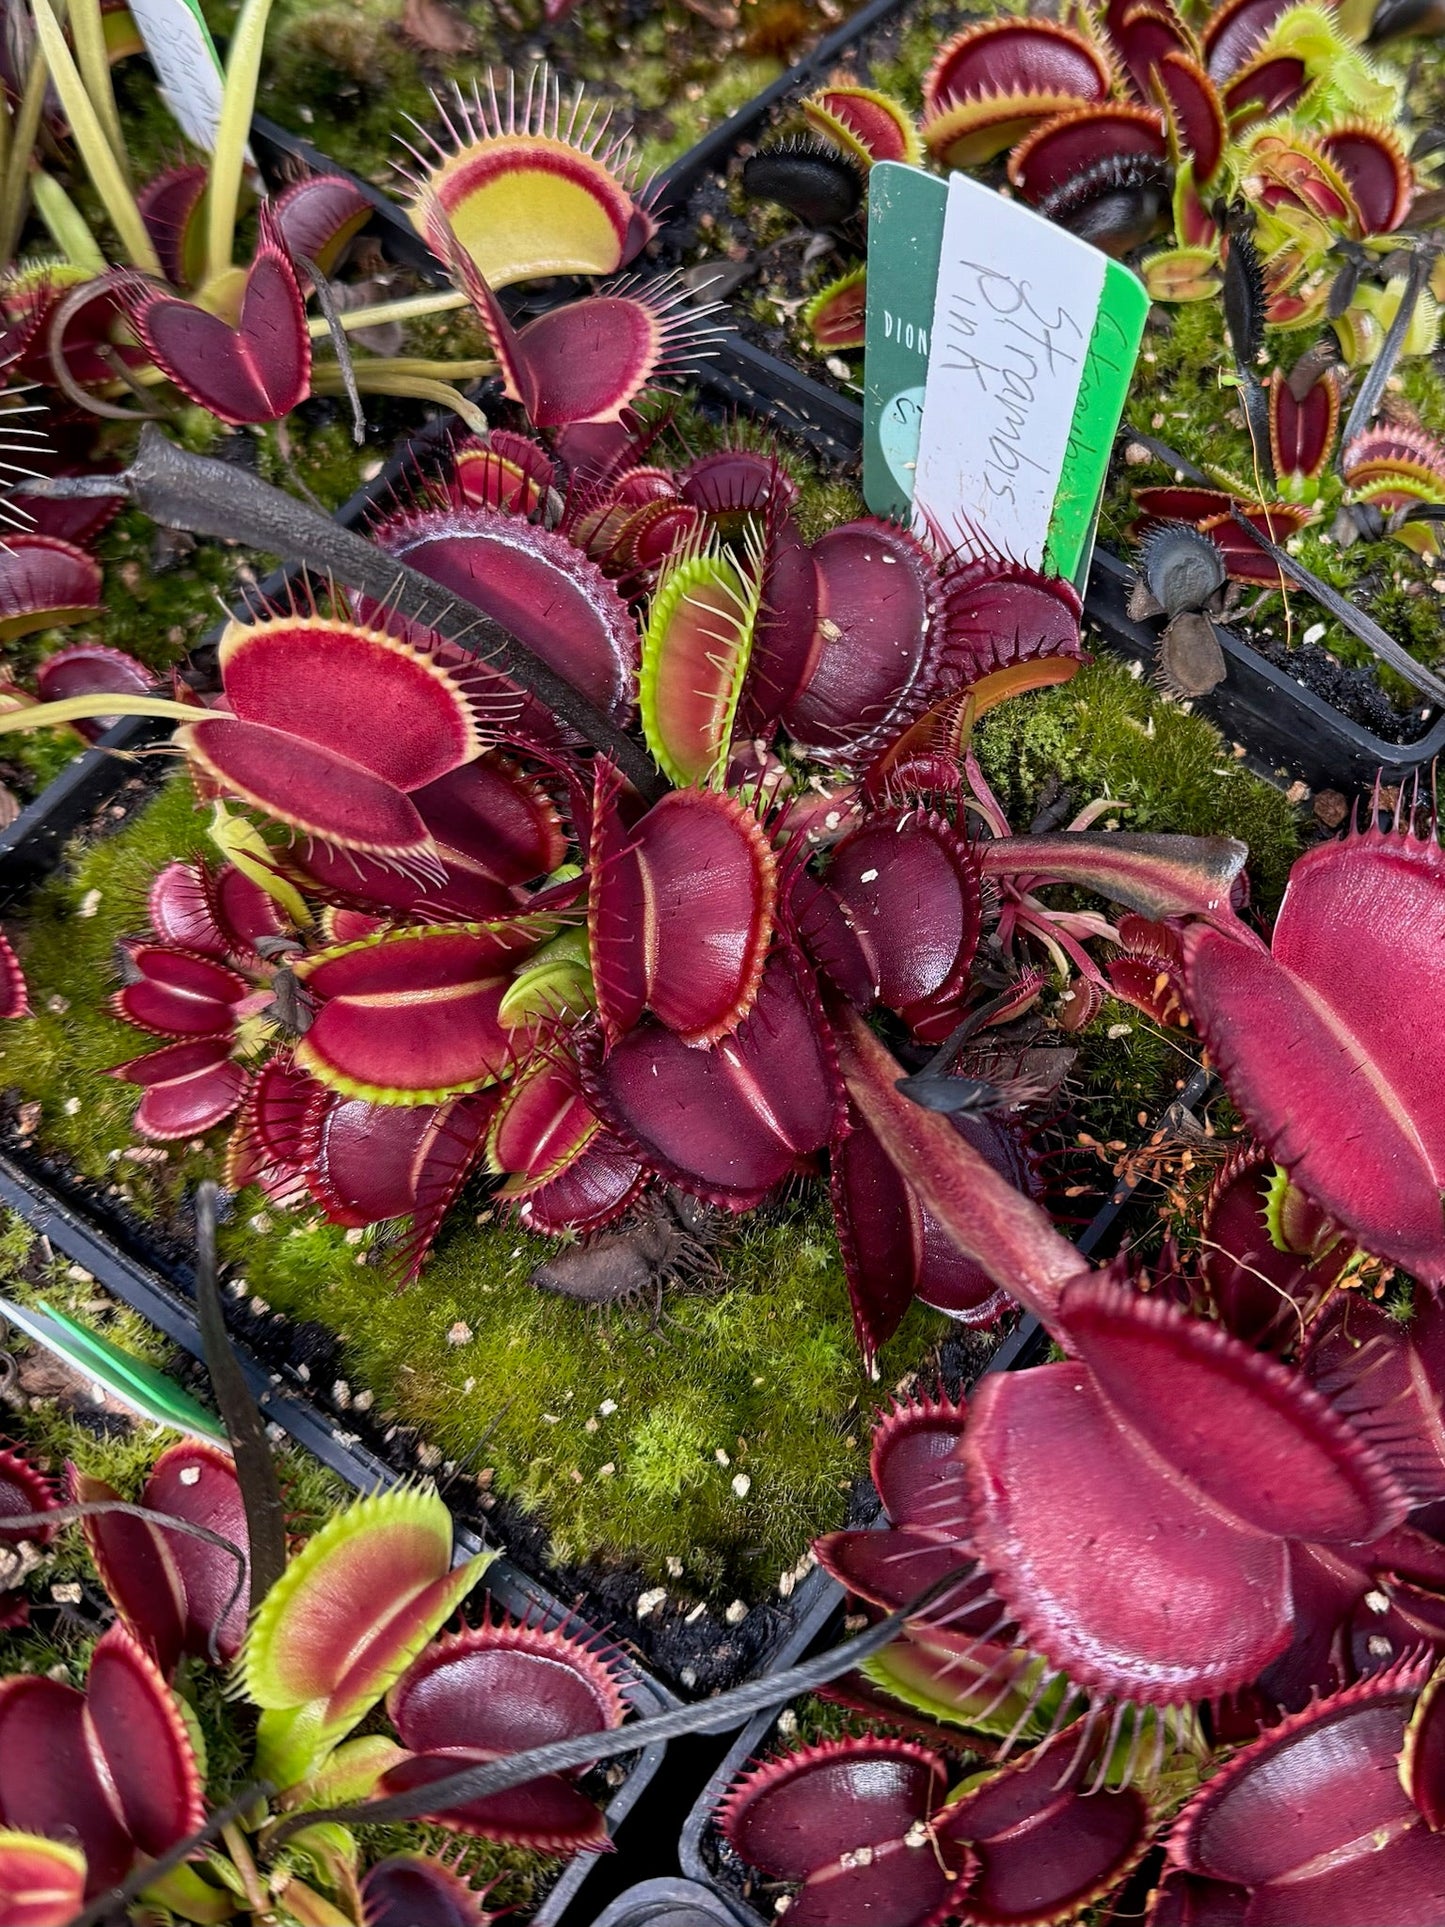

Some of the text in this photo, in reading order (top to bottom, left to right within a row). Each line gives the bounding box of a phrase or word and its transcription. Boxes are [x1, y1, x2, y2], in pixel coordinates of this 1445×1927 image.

[883, 309, 928, 356] DION
[940, 260, 1025, 392] Pink
[983, 280, 1083, 505] Strambis
